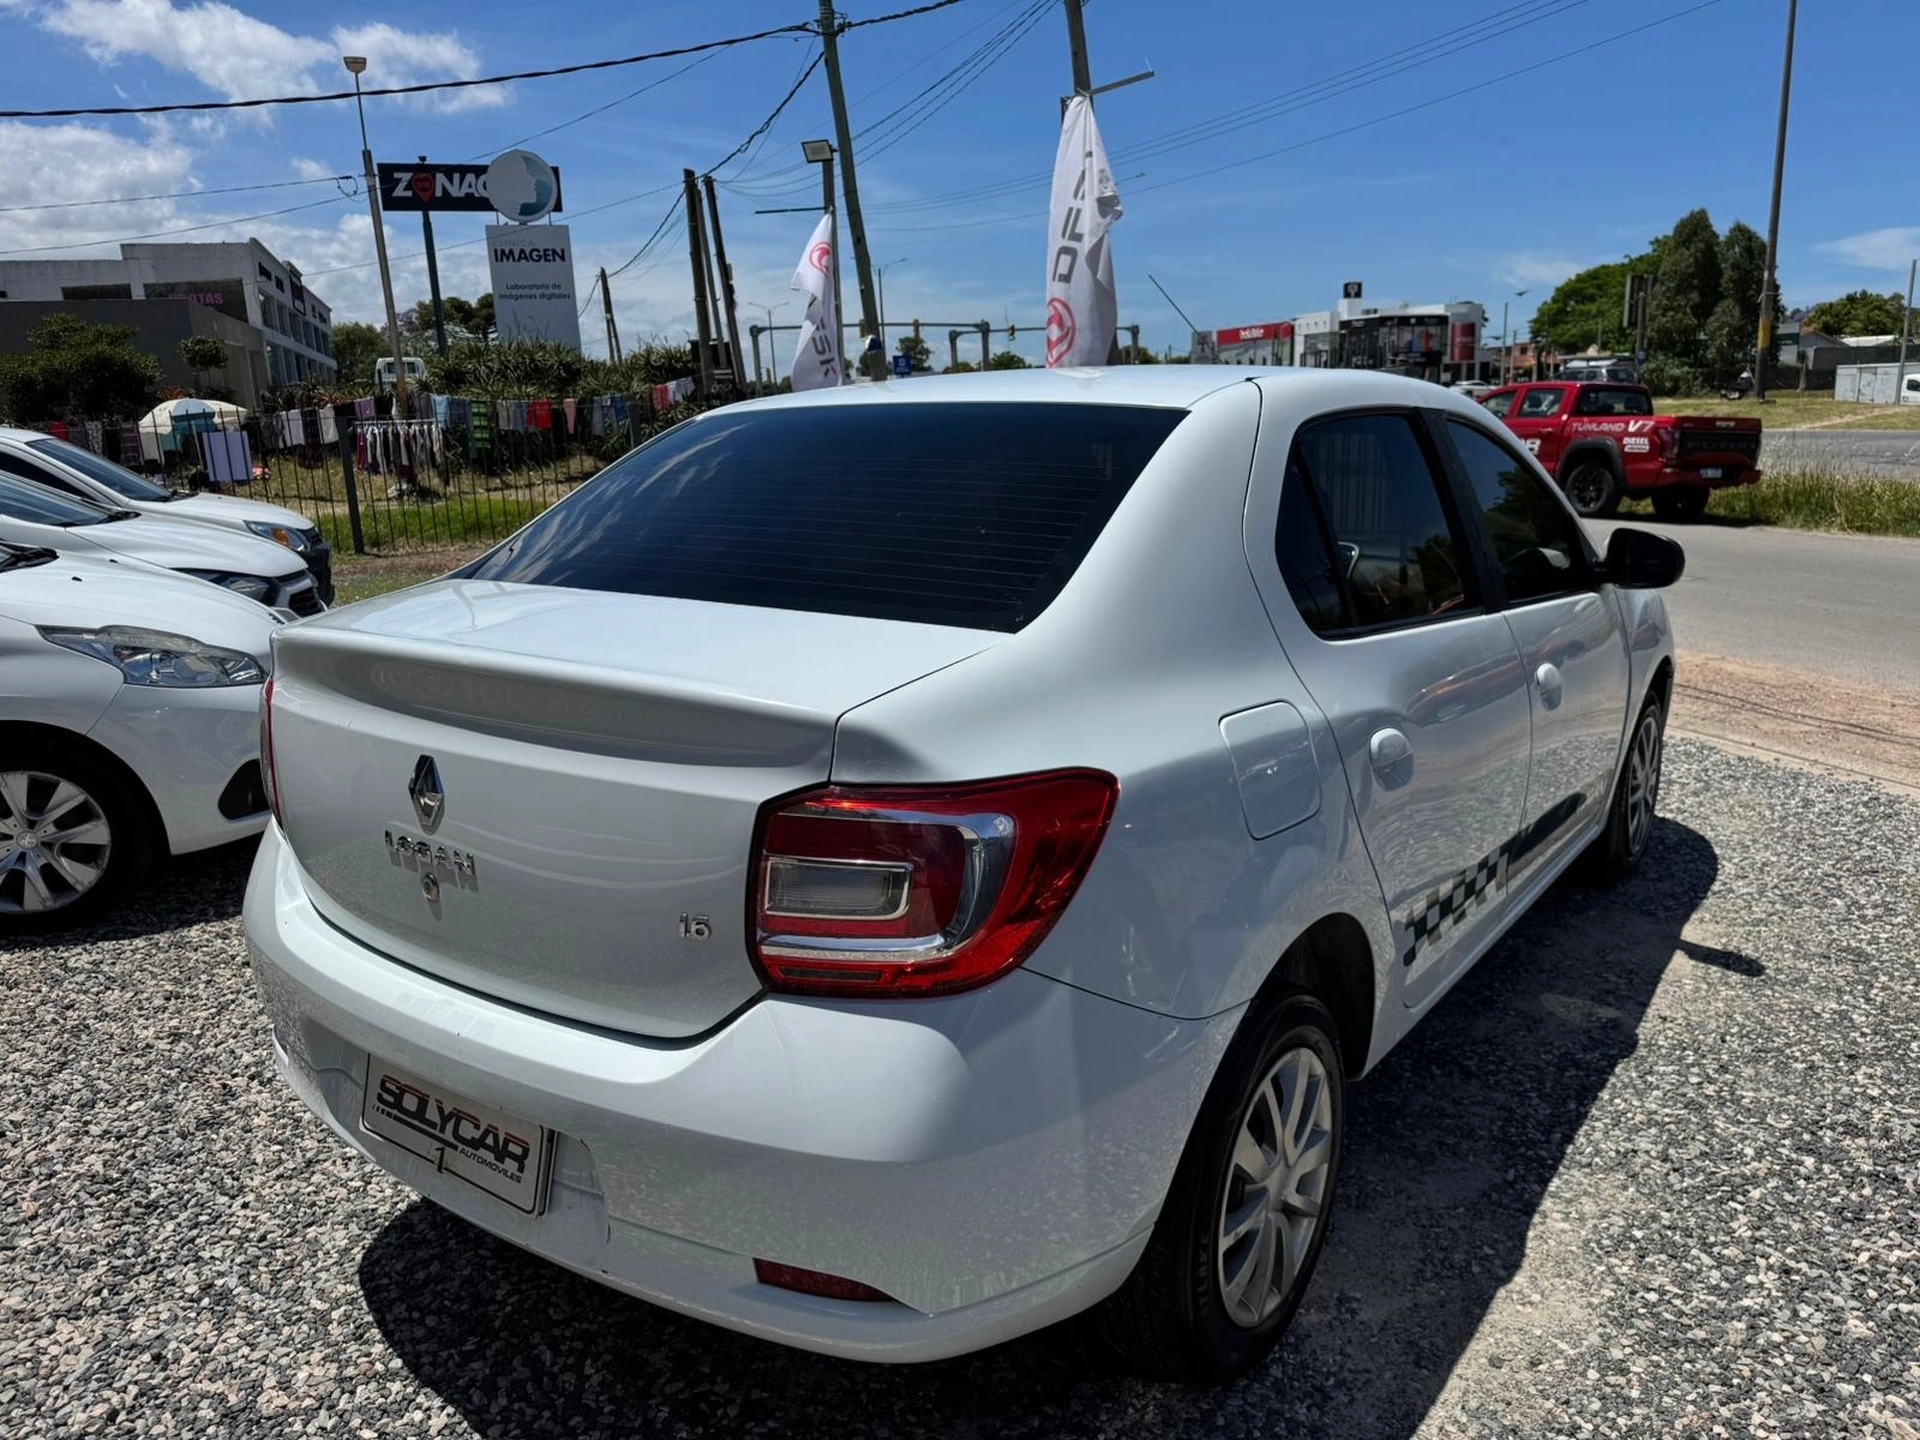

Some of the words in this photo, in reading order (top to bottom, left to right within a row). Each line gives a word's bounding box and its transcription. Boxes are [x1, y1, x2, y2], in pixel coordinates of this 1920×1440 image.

[494, 247, 566, 263] IMAGEN
[1572, 422, 1625, 433] TUNLAND
[1628, 419, 1655, 433] V7
[1622, 436, 1650, 445] DIESEL
[384, 829, 476, 876] LOGAN
[376, 1074, 530, 1174] SOLYCAR
[459, 1149, 523, 1184] AUTOMOVILES
